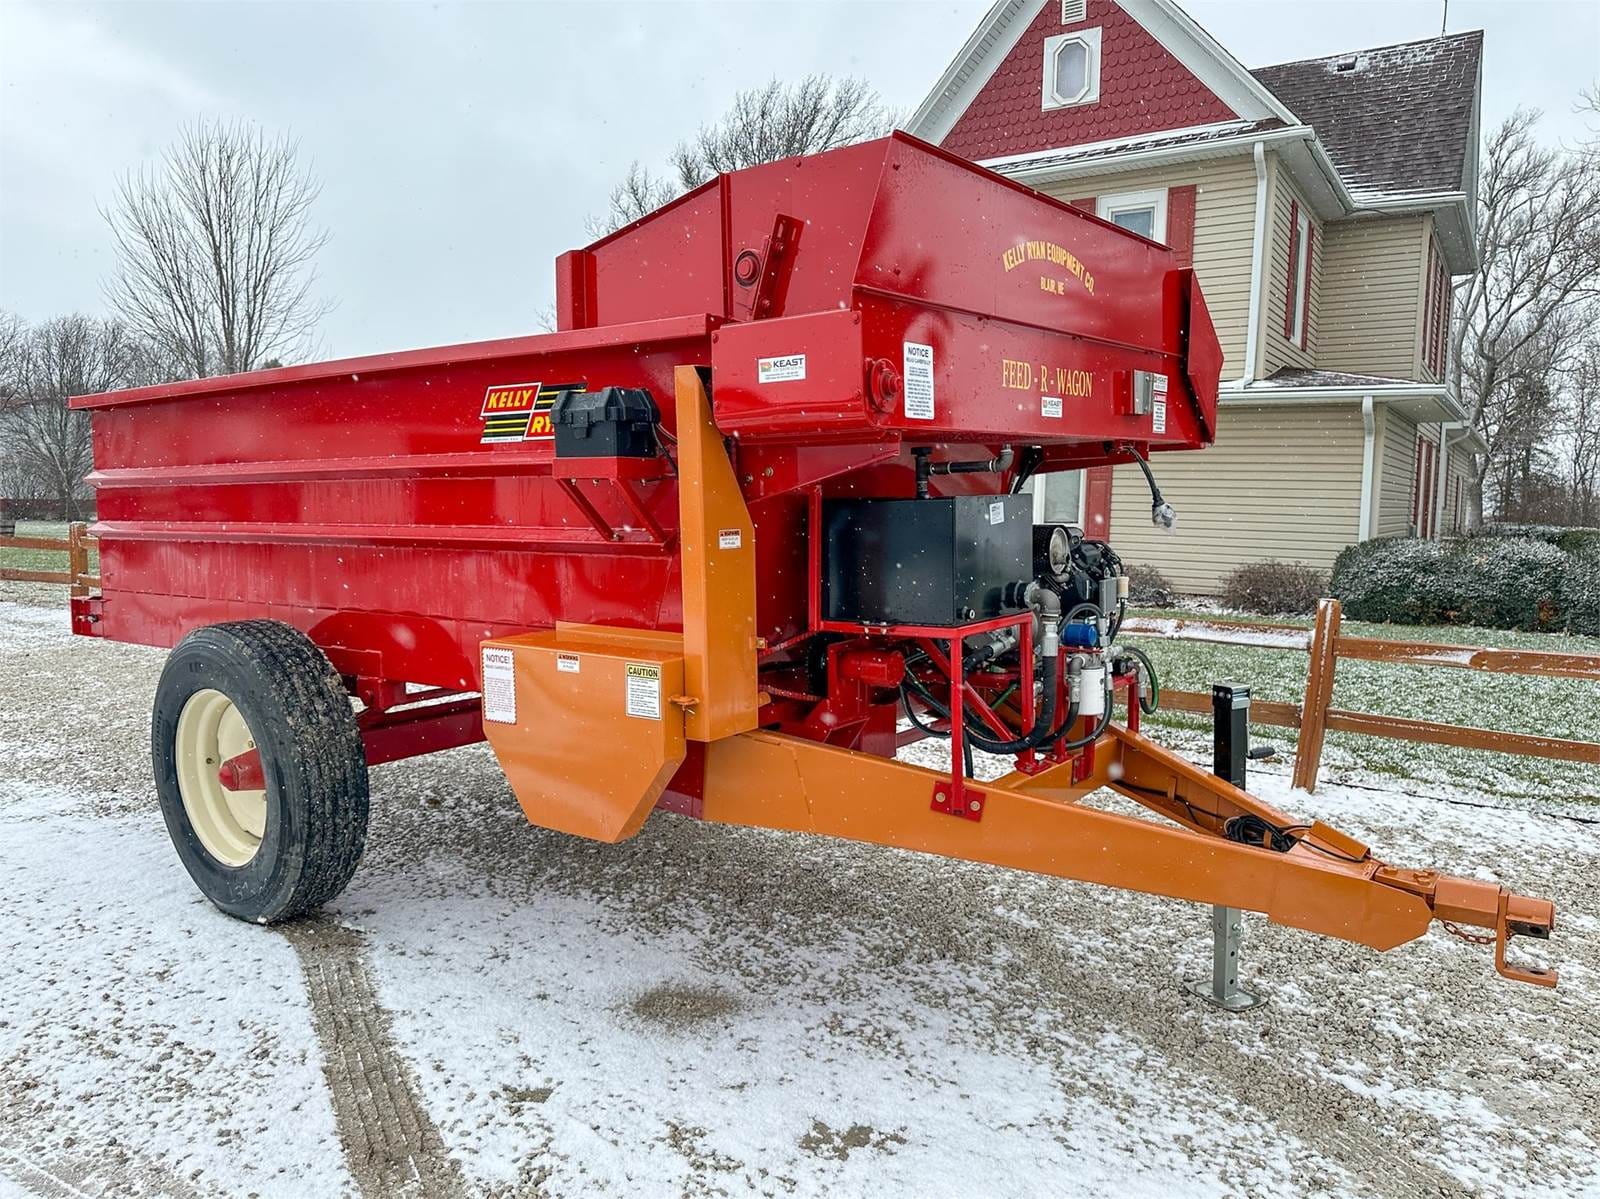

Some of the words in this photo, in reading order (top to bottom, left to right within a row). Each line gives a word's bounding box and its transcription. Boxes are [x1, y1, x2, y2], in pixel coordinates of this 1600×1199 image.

[1002, 243, 1025, 273] KELLY
[1026, 240, 1046, 261] RYAN
[1046, 242, 1085, 281] EQUIPMENT
[1084, 271, 1095, 296] CO.
[908, 347, 929, 358] NOTICE
[773, 357, 804, 368] KEAST
[1002, 359, 1032, 390] FEED
[1040, 365, 1048, 393] R
[1056, 367, 1093, 398] WAGON
[487, 389, 533, 409] KELLY
[530, 415, 553, 433] RY
[486, 654, 511, 665] NOTICE!
[628, 666, 658, 678] CAUTION
